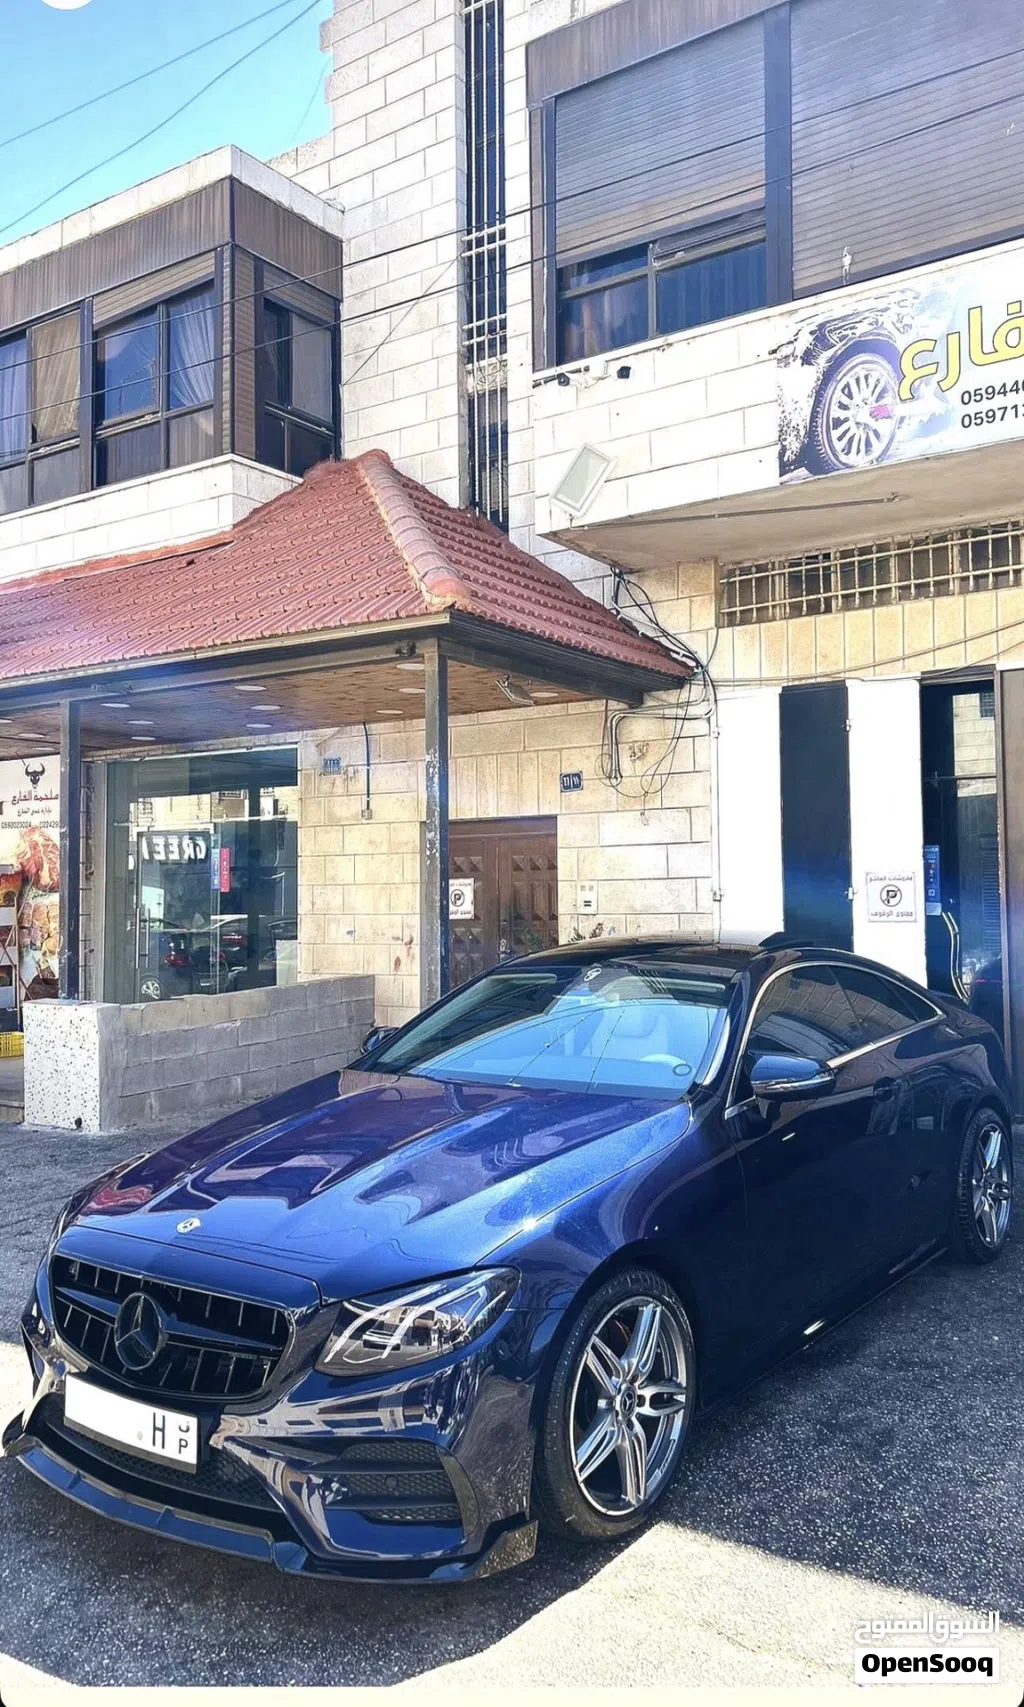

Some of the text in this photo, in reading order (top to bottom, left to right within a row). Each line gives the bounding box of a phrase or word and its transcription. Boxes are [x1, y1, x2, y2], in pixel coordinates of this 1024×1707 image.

[11, 788, 59, 805] ملحمة الفارع
[871, 909, 893, 918] الوقوف
[152, 1412, 165, 1449] H
[178, 1438, 188, 1454] P
